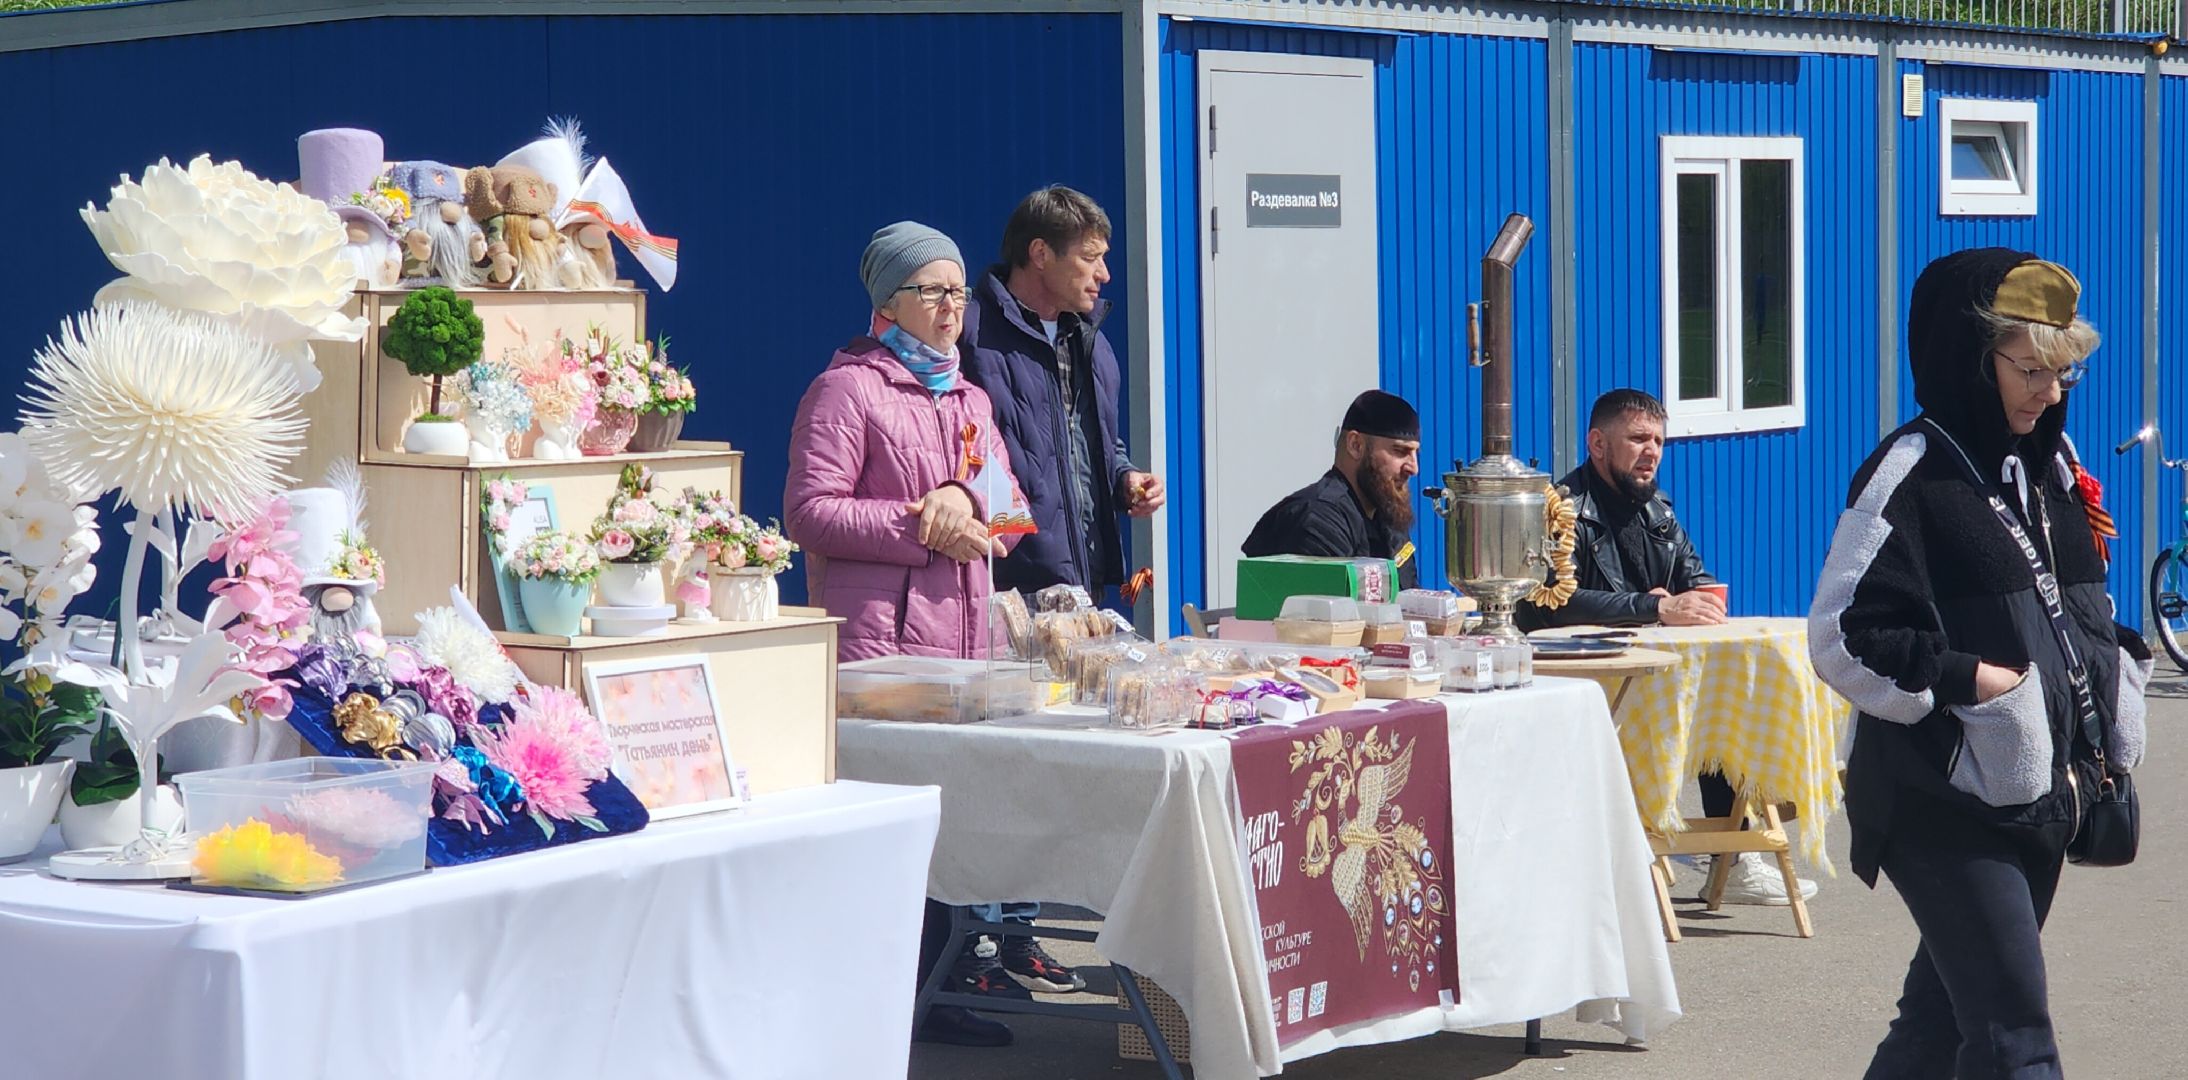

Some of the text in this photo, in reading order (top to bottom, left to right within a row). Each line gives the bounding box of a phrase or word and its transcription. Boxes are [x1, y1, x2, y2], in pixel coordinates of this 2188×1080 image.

[1251, 190, 1339, 209] Раздевалка №3
[608, 714, 715, 740] Творческая мастерская
[1275, 931, 1313, 953] КУЛЬТУРЕ
